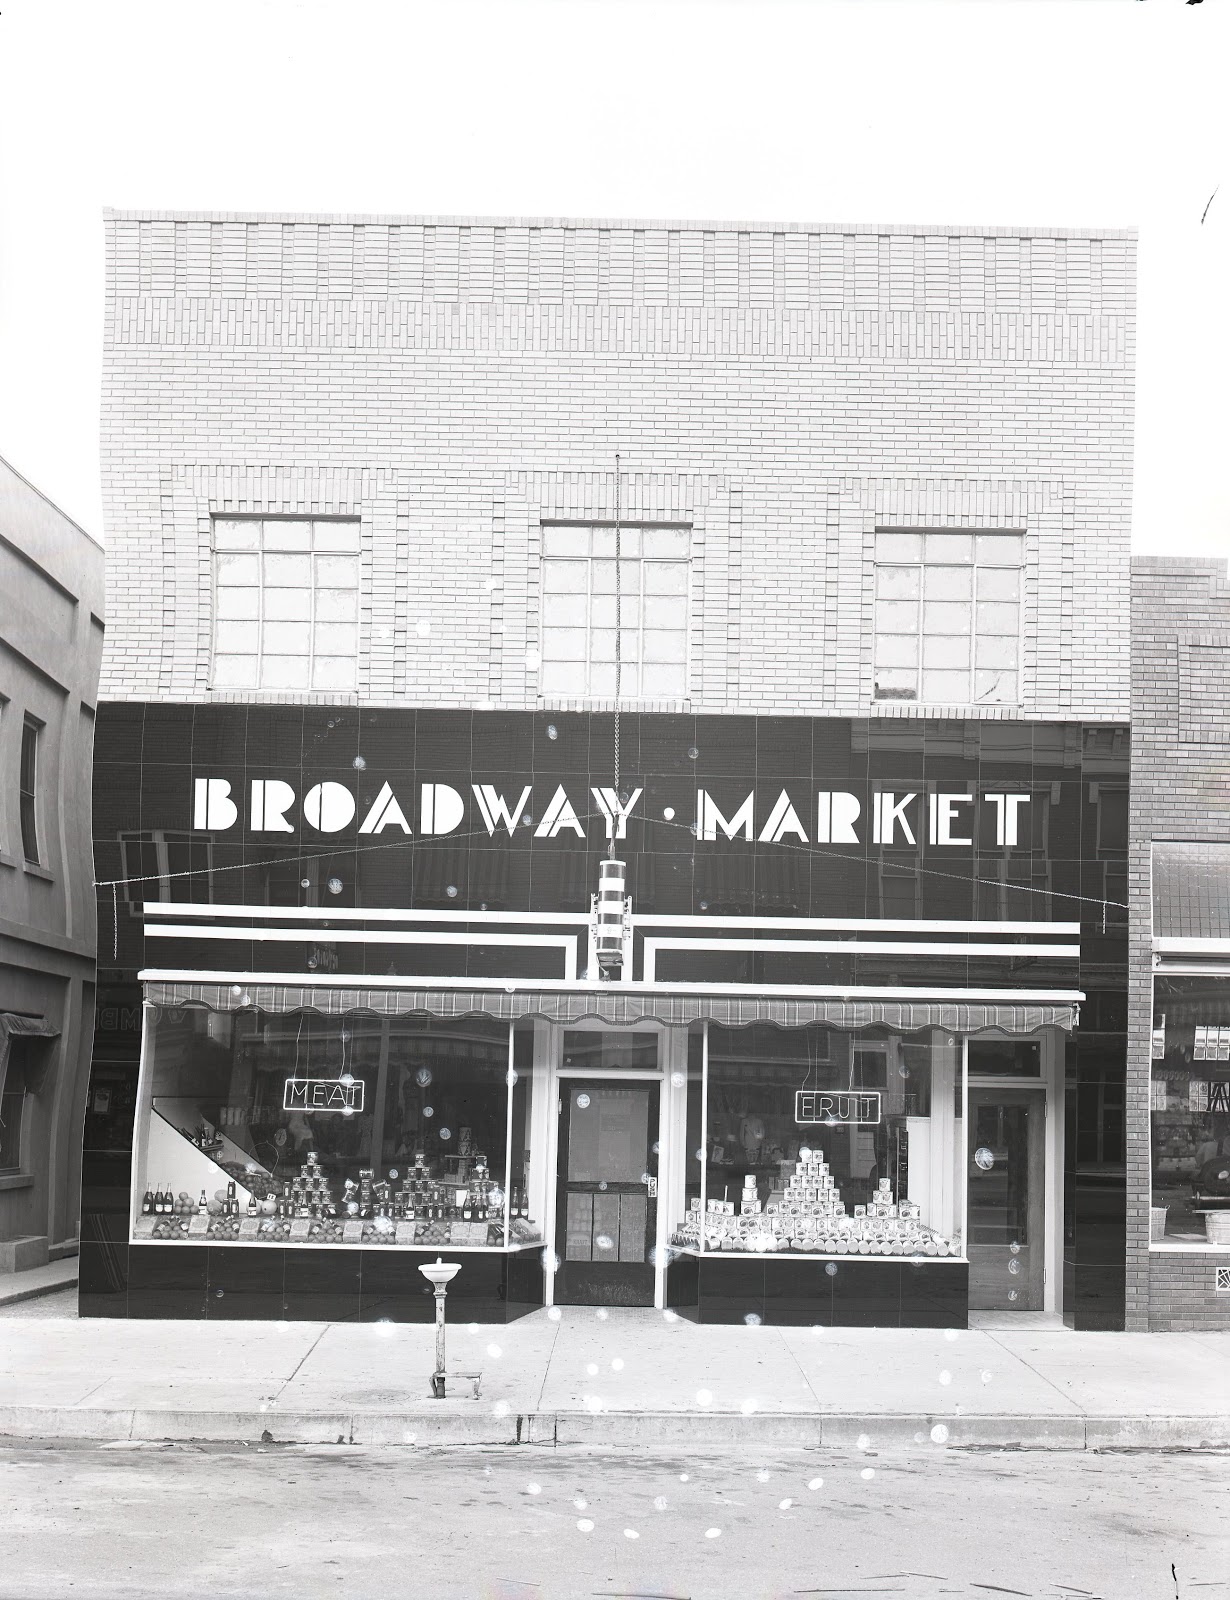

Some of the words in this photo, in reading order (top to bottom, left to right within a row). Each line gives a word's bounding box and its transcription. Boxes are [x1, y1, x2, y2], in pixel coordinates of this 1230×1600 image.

[193, 778, 644, 840] BROADWAY
[696, 789, 1031, 847] MARKET
[290, 1083, 361, 1106] MEAT
[802, 1096, 877, 1119] FRUIT
